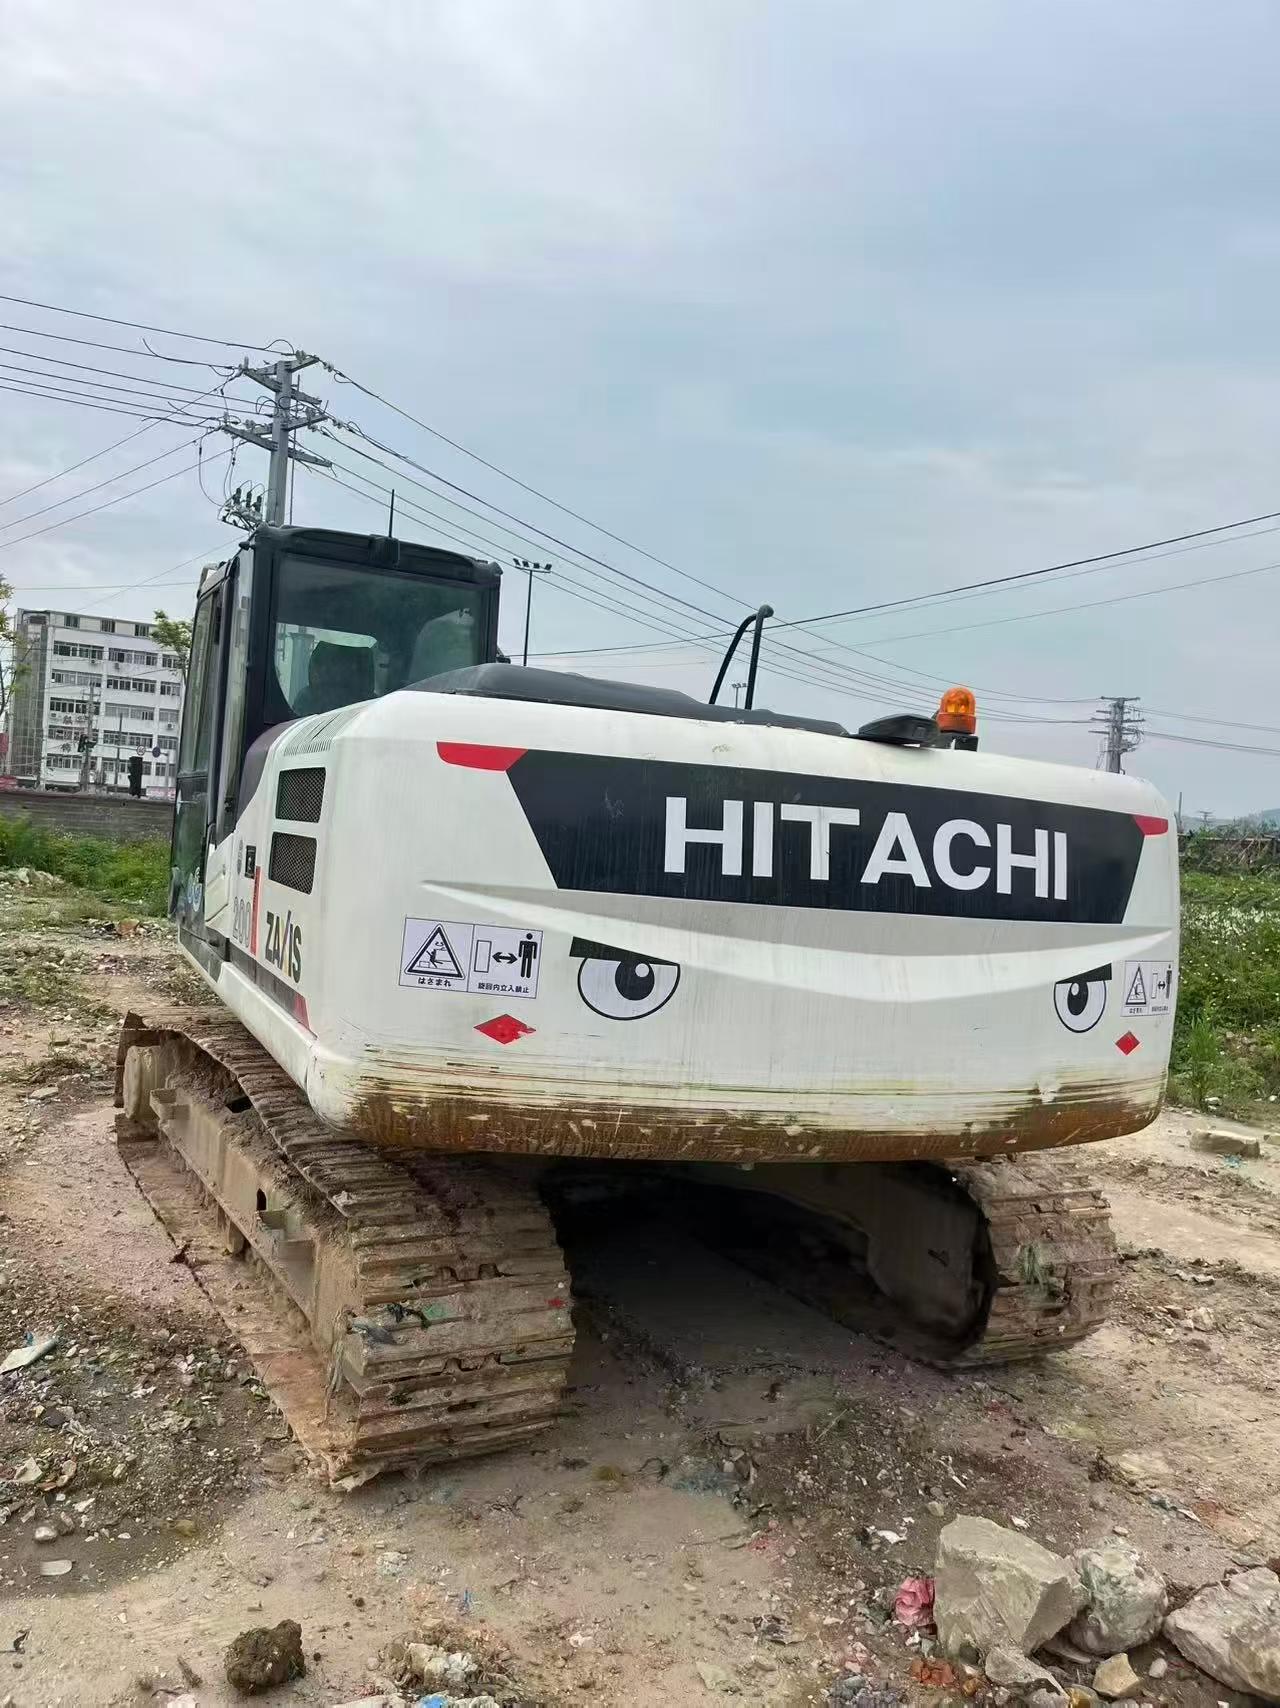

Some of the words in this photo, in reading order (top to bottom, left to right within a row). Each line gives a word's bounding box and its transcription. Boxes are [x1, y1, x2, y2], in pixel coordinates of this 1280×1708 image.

[664, 796, 1068, 900] HITACHI
[418, 977, 452, 987] はさまれ
